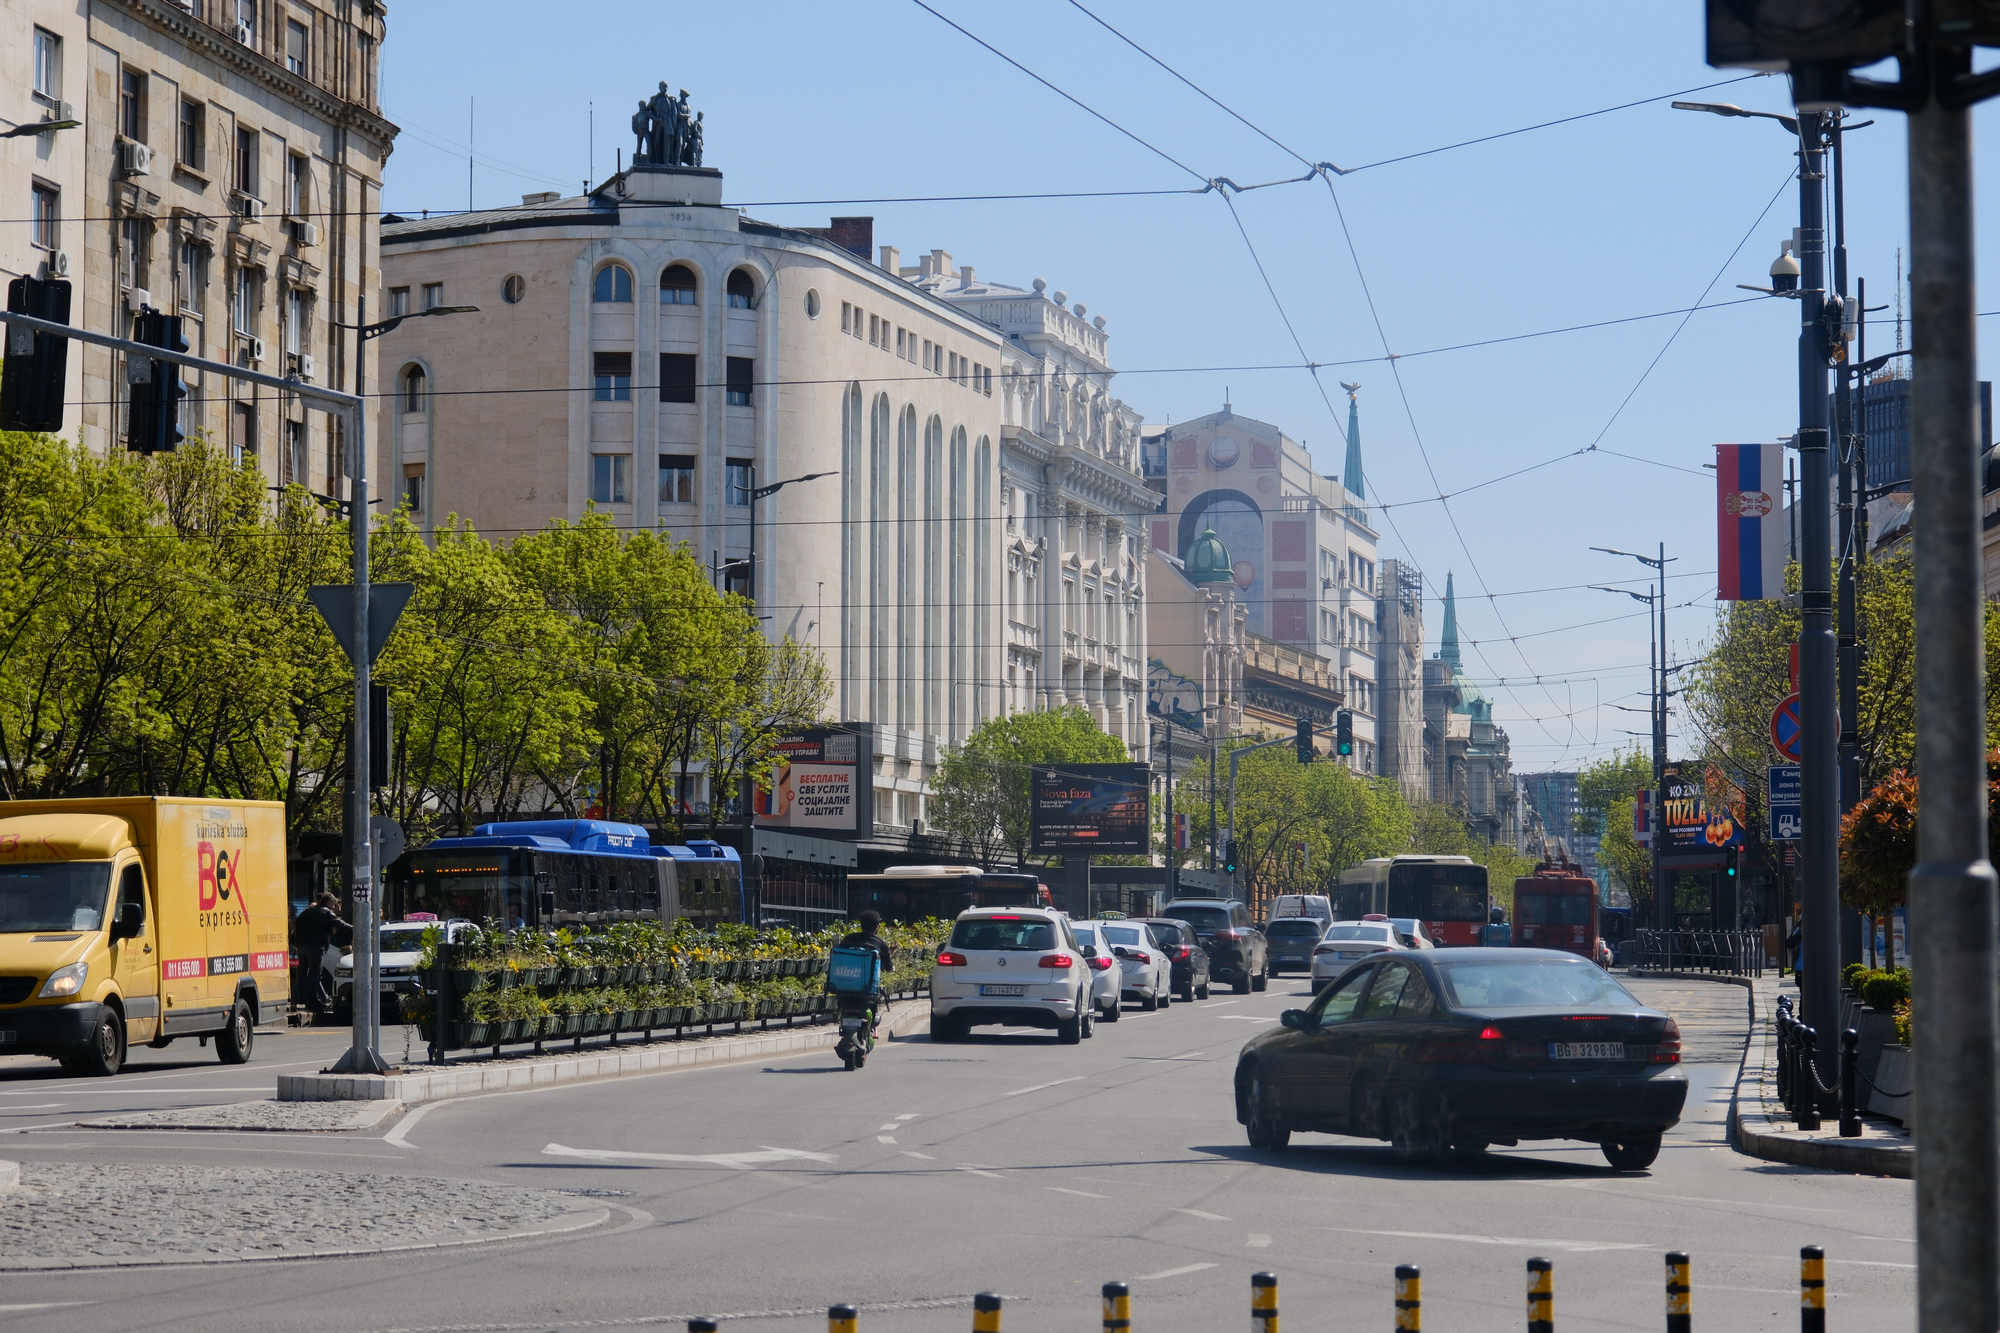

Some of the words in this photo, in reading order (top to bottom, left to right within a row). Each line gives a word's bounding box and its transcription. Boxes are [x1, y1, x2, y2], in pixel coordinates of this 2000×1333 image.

[795, 749, 819, 757] УПРАВА!
[800, 774, 849, 783] БЕСПЛАТНЕ
[799, 785, 815, 795] СВЕ
[817, 785, 849, 794] УСЛУГЕ
[1040, 789, 1067, 799] Nova
[1070, 787, 1091, 799] faza
[798, 796, 850, 806] СОЦИЈАЛНЕ
[804, 806, 844, 816] ЗАШТИТЕ
[1664, 799, 1707, 826] TOZLA
[196, 824, 225, 839] kurirska
[227, 823, 248, 838] služba
[200, 910, 242, 931] express
[226, 957, 234, 972] 555
[234, 956, 243, 971] 000
[265, 953, 274, 968] 640
[168, 962, 177, 978] 011
[181, 961, 190, 976] 555
[191, 960, 200, 975] 000
[985, 986, 993, 994] BG
[1556, 1044, 1571, 1057] BG
